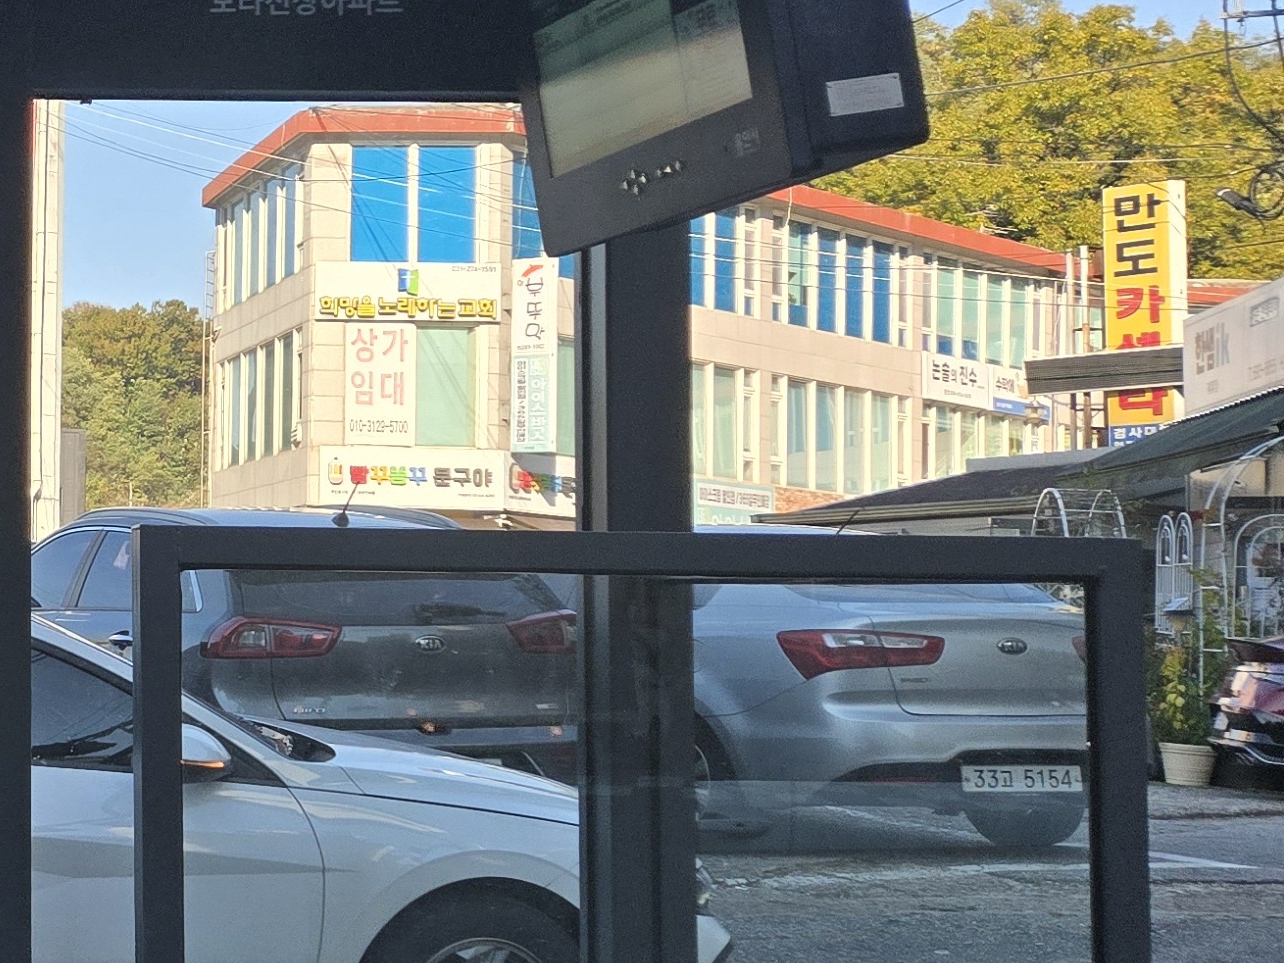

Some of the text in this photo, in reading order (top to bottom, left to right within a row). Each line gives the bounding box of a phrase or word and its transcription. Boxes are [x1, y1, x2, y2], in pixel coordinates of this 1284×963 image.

[319, 295, 497, 319] 희망을 노래하는 교회
[350, 328, 408, 362] 상가
[350, 371, 404, 405] 임대
[433, 467, 493, 488] 문구야
[974, 769, 1072, 788] 33고 5154
